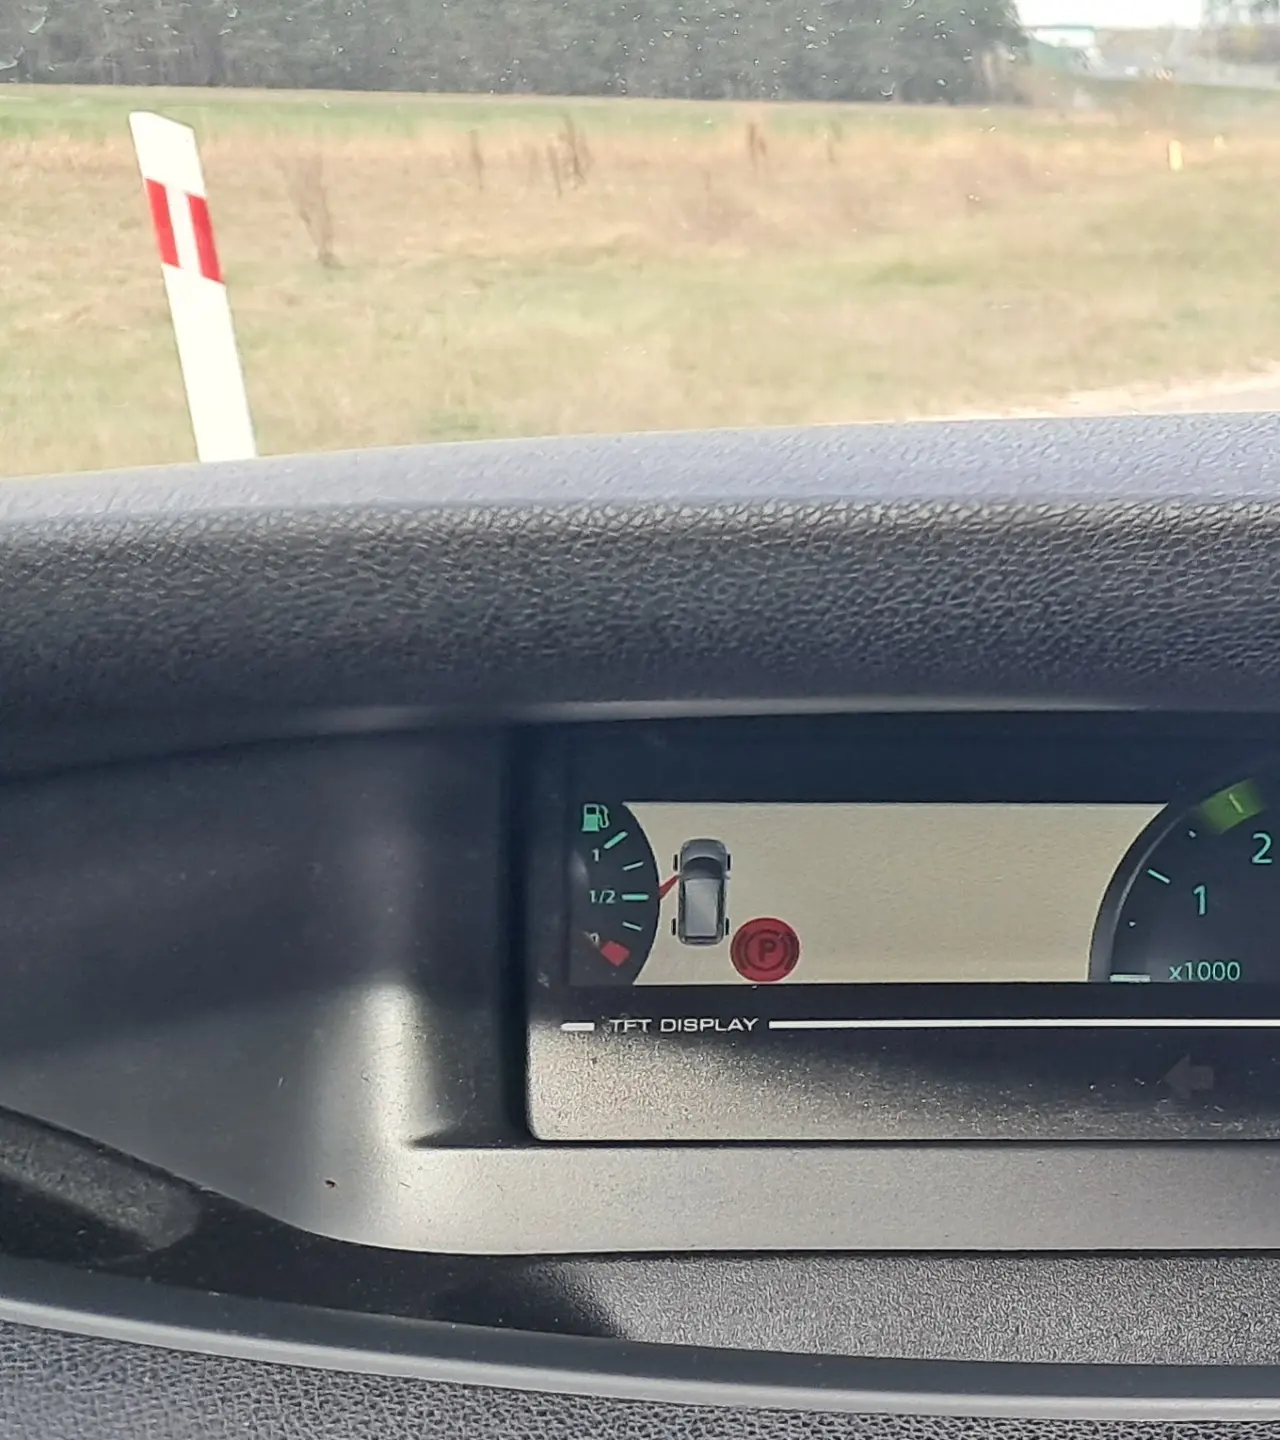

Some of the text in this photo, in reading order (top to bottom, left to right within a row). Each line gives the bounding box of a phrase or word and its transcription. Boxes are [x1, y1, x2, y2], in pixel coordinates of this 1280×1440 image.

[1251, 832, 1274, 864] 2
[589, 889, 616, 904] 1/2
[1192, 884, 1207, 915] 1
[1168, 960, 1241, 982] x1000
[609, 1018, 760, 1033] TFT DISPLAY
